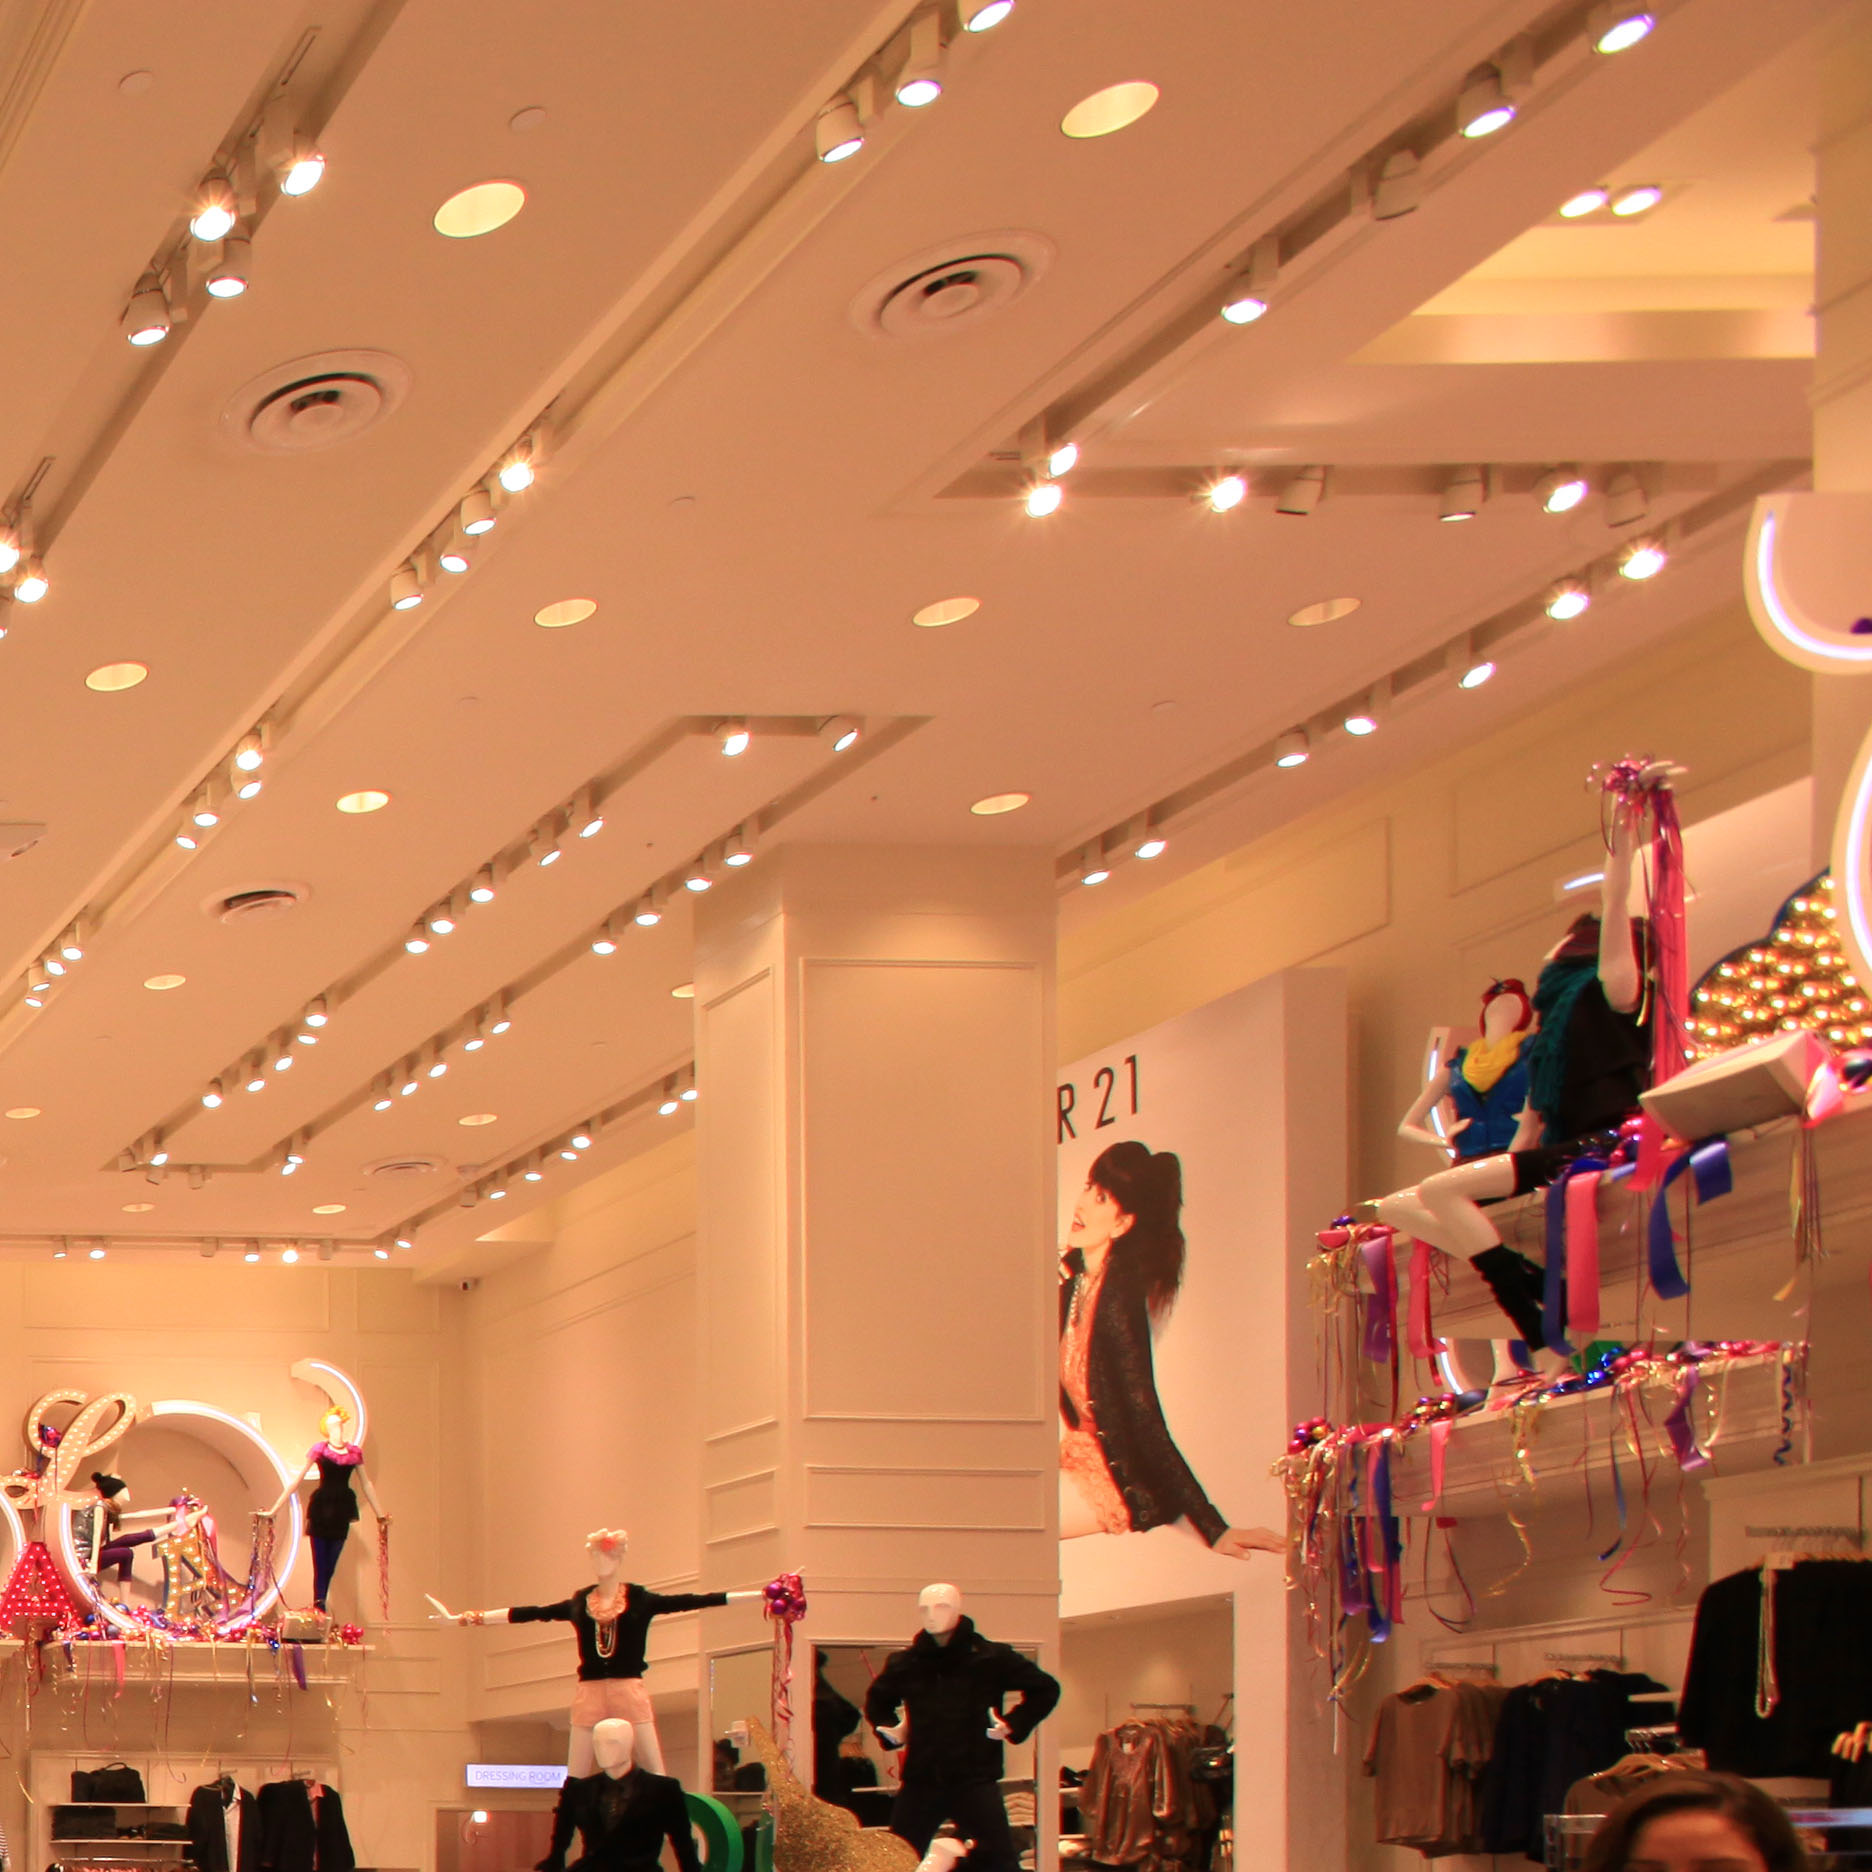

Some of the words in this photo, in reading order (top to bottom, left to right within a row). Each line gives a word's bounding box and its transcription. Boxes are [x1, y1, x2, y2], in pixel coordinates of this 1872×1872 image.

[1093, 1053, 1141, 1127] 21
[474, 1770, 526, 1782] DRESSING
[528, 1771, 561, 1782] ROOM
